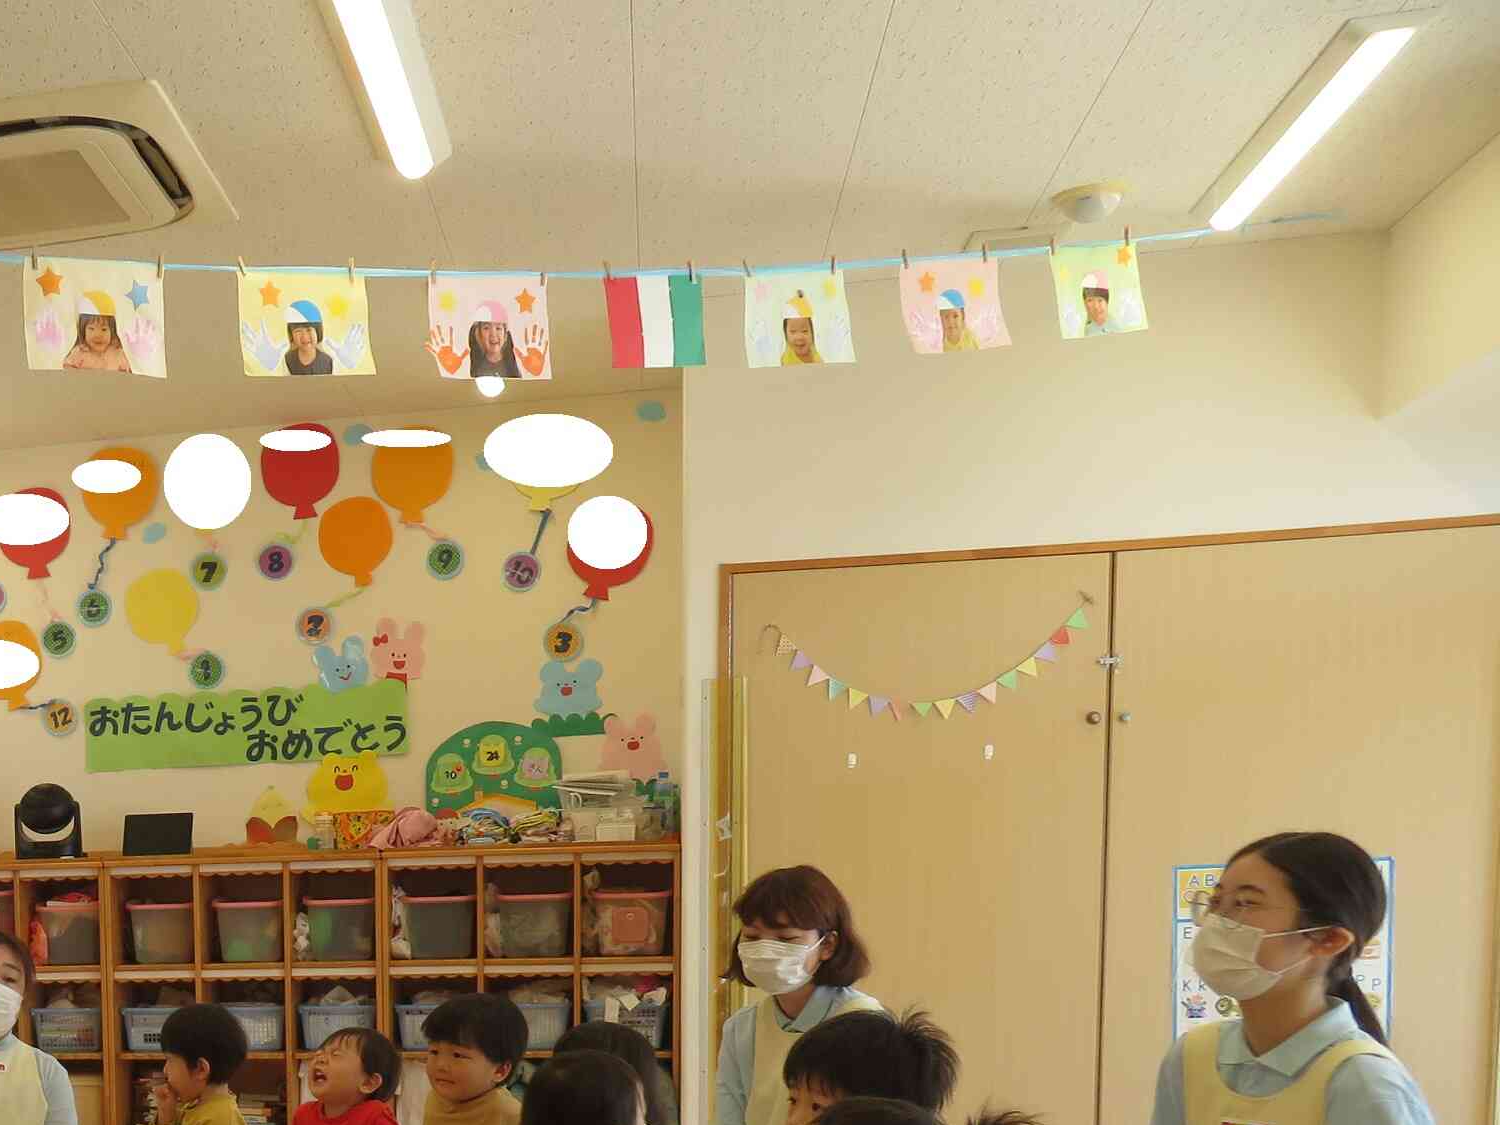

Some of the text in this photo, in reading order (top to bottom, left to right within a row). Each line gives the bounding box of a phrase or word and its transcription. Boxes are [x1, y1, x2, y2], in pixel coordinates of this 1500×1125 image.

[269, 551, 284, 572] 8
[439, 549, 453, 568] 9
[200, 561, 217, 582] 7
[510, 558, 534, 584] 10
[307, 614, 325, 638] 2
[51, 629, 68, 650] 5
[554, 631, 572, 653] 3
[50, 707, 73, 728] 12
[88, 694, 304, 736] おたんじょうび
[246, 714, 407, 762] おめでとう
